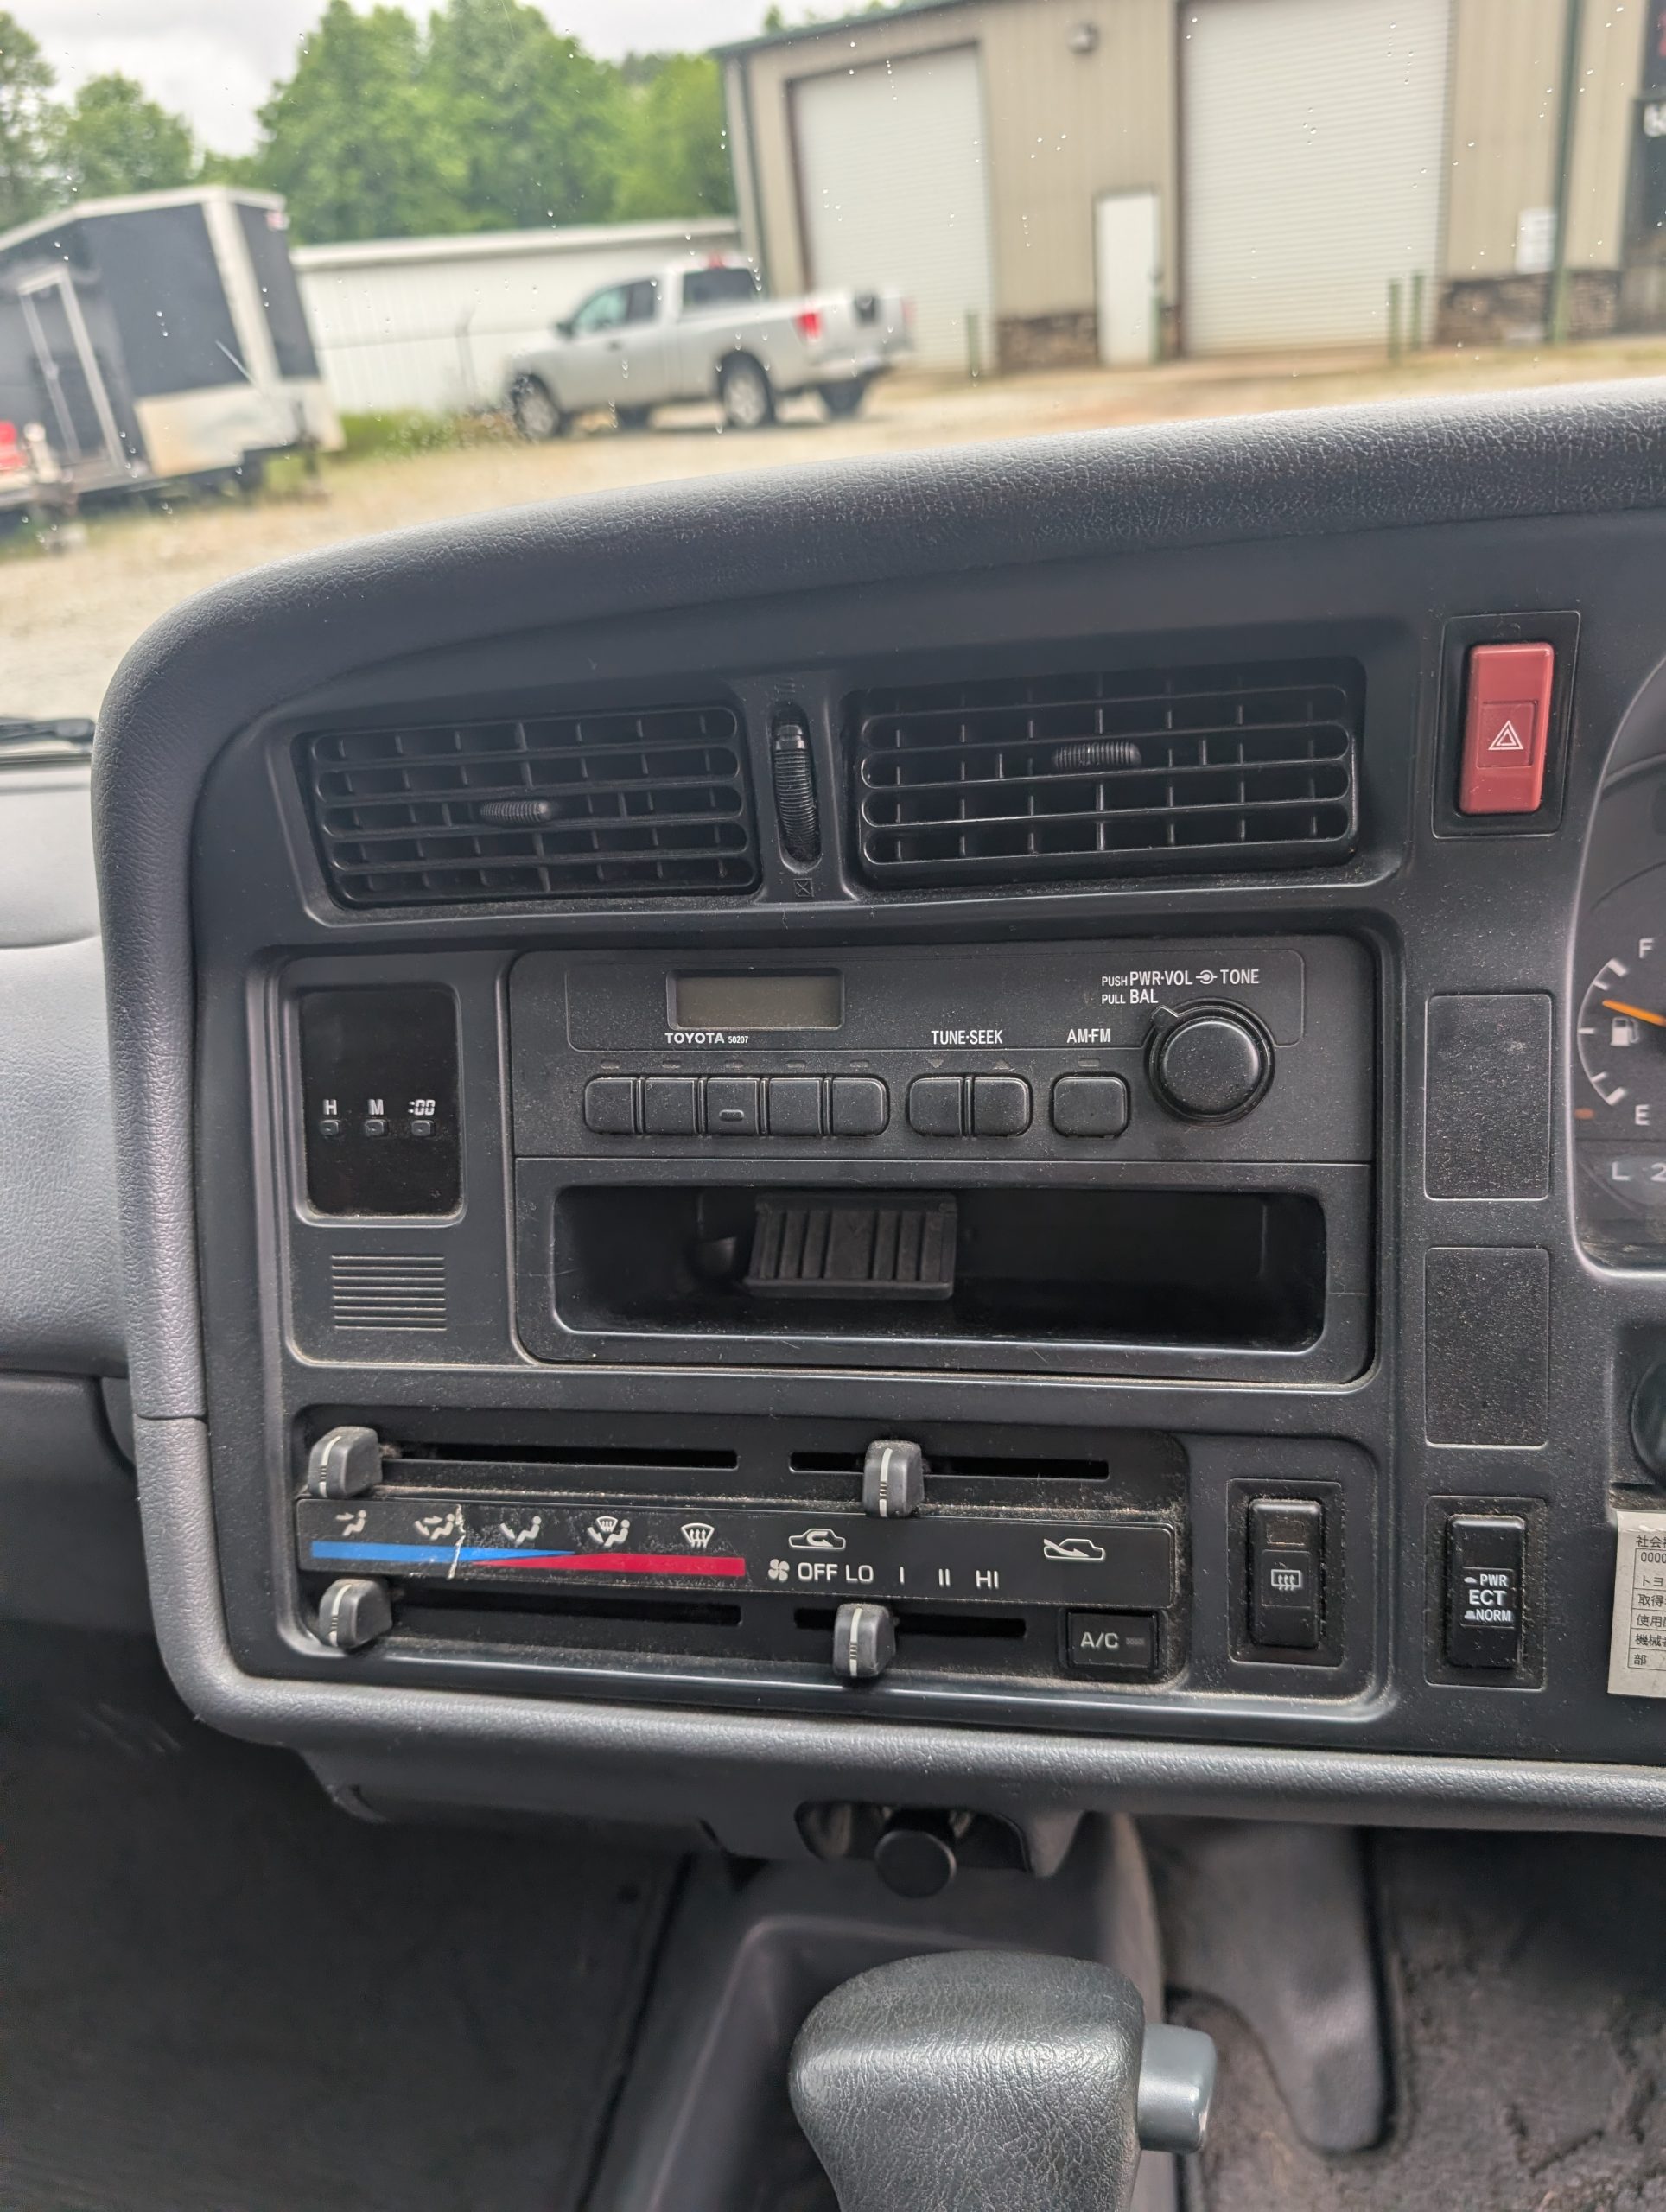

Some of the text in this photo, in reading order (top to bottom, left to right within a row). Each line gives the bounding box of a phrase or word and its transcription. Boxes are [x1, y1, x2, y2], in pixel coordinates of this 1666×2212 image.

[1638, 938, 1654, 958] F
[1102, 976, 1127, 986] PUSH
[1220, 969, 1259, 984] TONE
[1102, 989, 1158, 1004] PULL BAL
[665, 1033, 749, 1044] TOYOTA 50207
[323, 1099, 338, 1115] H
[368, 1099, 385, 1115] M
[1635, 1104, 1650, 1125] E
[1612, 1162, 1666, 1182] L 2
[1636, 1535, 1666, 1548] 社会
[798, 1563, 837, 1580] OFF
[846, 1565, 873, 1582] LO
[976, 1570, 998, 1588] HI
[1479, 1573, 1509, 1587] PWR
[1643, 1576, 1663, 1586] トヨ
[1470, 1590, 1506, 1605] ECT
[1638, 1594, 1666, 1607] 取得
[1476, 1608, 1512, 1623] NORM
[1637, 1614, 1666, 1627] 使用
[1081, 1632, 1118, 1649] A/C
[1634, 1654, 1647, 1665] 部
